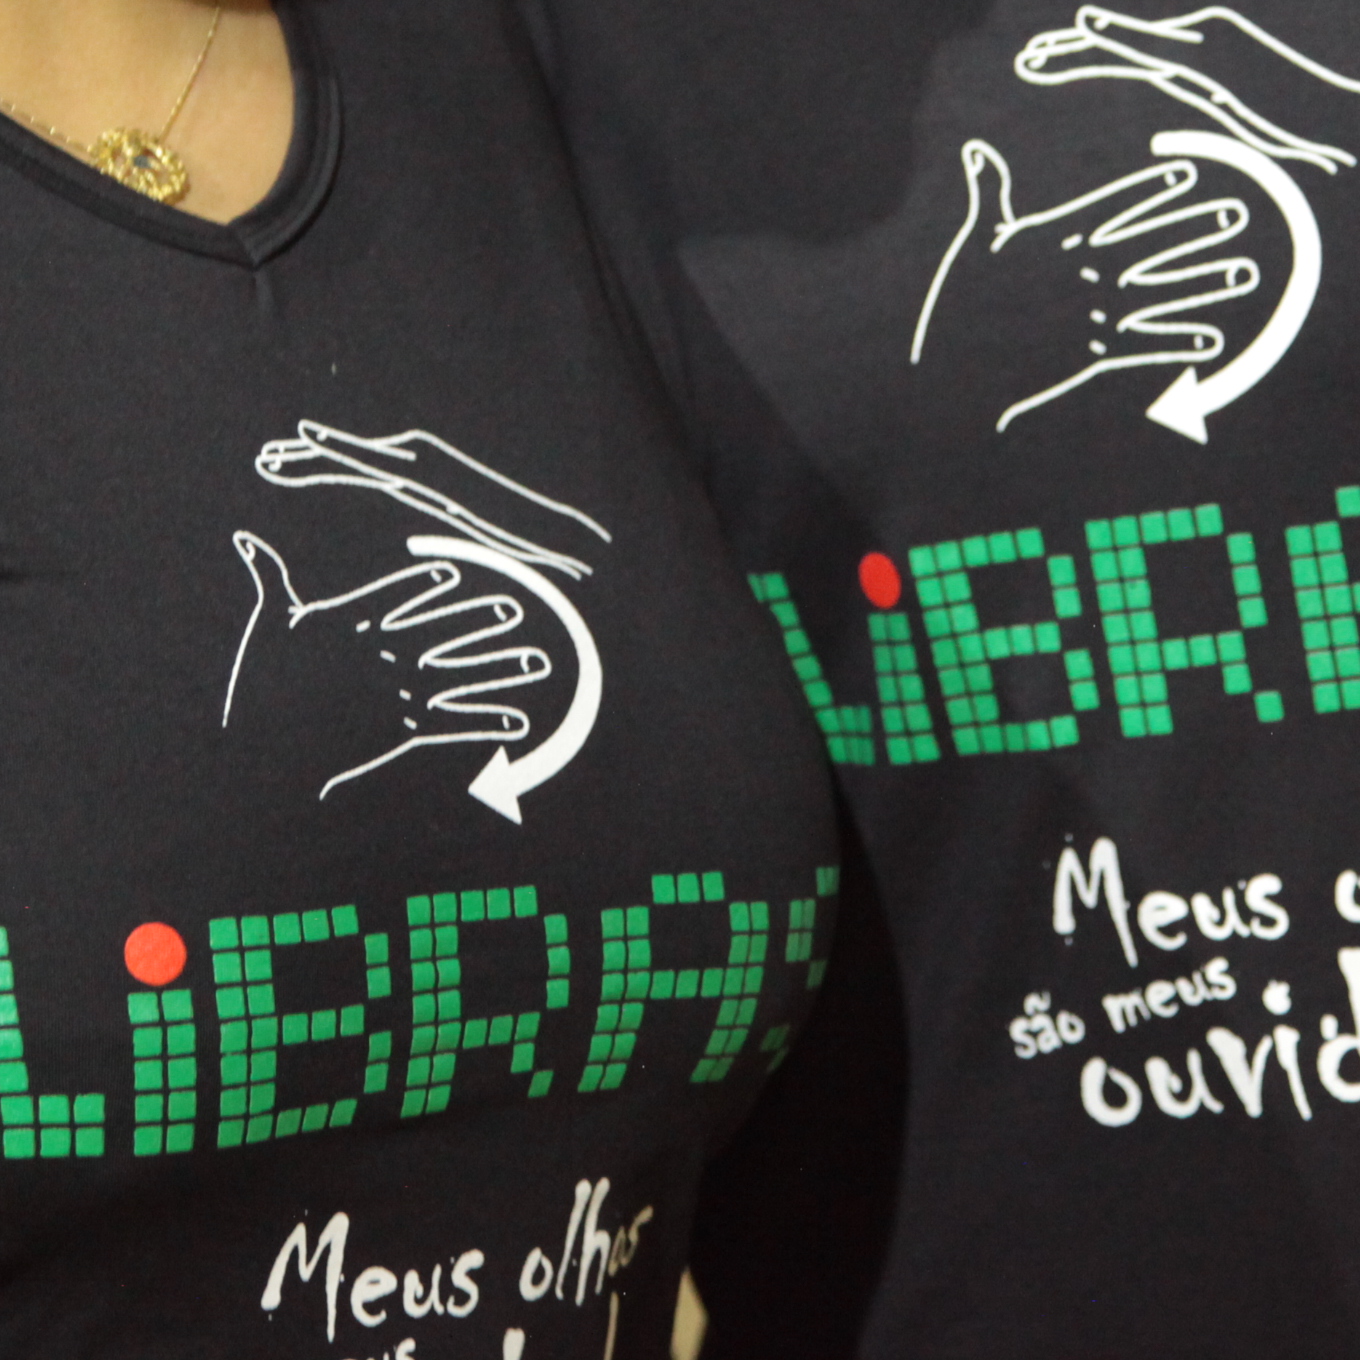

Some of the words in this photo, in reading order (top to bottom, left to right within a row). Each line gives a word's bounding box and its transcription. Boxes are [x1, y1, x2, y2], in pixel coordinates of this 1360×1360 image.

[1053, 837, 1290, 967] Meus
[1009, 990, 1086, 1058] são
[1102, 956, 1237, 1034] meus
[260, 1211, 485, 1343] Meus
